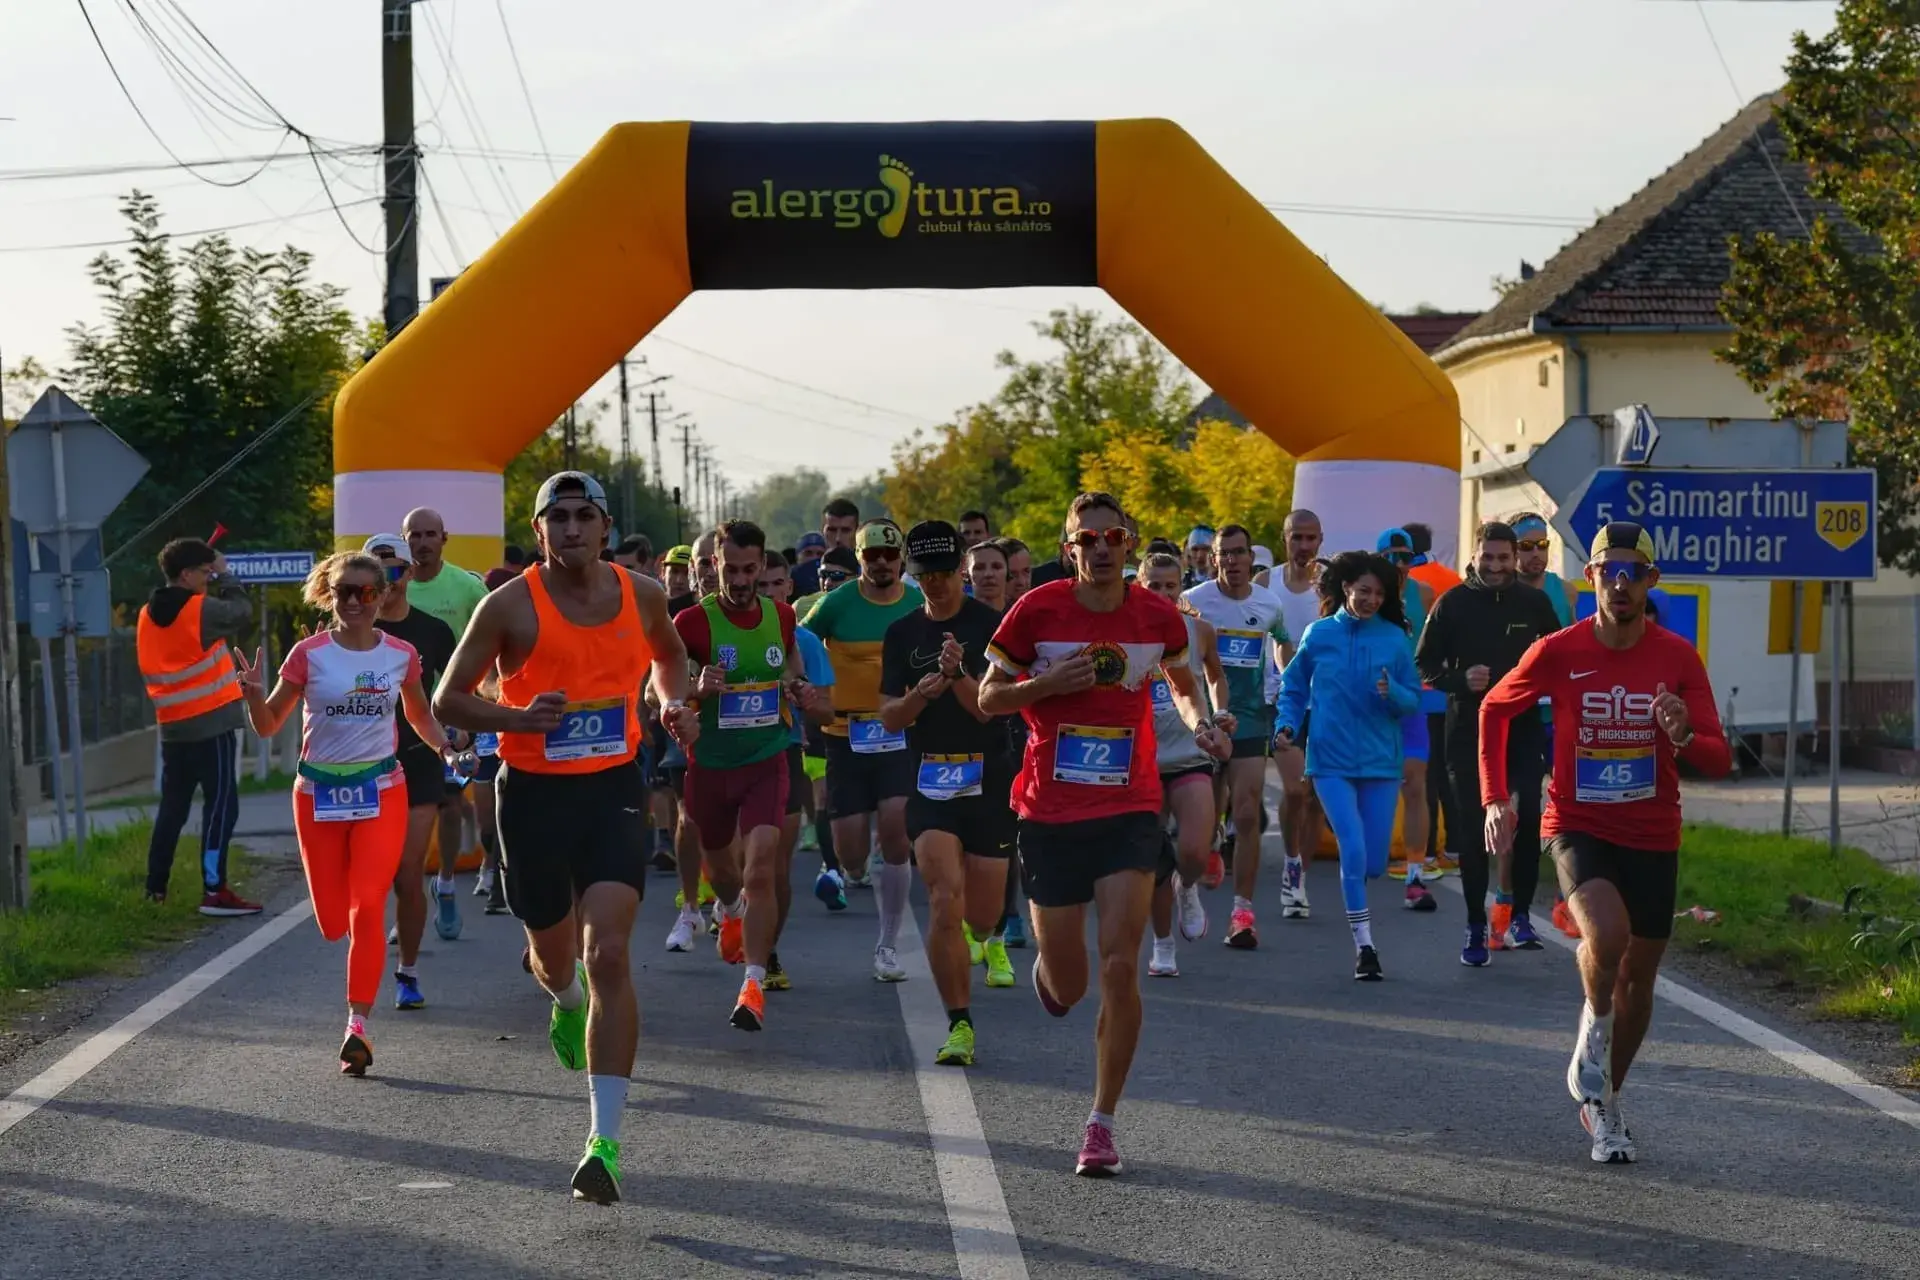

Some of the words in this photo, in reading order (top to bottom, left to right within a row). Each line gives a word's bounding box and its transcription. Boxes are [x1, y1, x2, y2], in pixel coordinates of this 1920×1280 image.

[917, 220, 962, 233] clubul
[1626, 479, 1808, 518] Sânmartinu
[1596, 502, 1614, 525] 5
[1822, 508, 1862, 533] 208
[1653, 525, 1788, 573] Maghiar
[1229, 639, 1250, 654] 57
[325, 704, 384, 717] ORADEA
[738, 695, 763, 713] 79
[567, 715, 603, 739] 20
[1081, 742, 1111, 765] 72
[936, 766, 964, 784] 24
[1598, 763, 1633, 784] 45
[327, 785, 365, 804] 101
